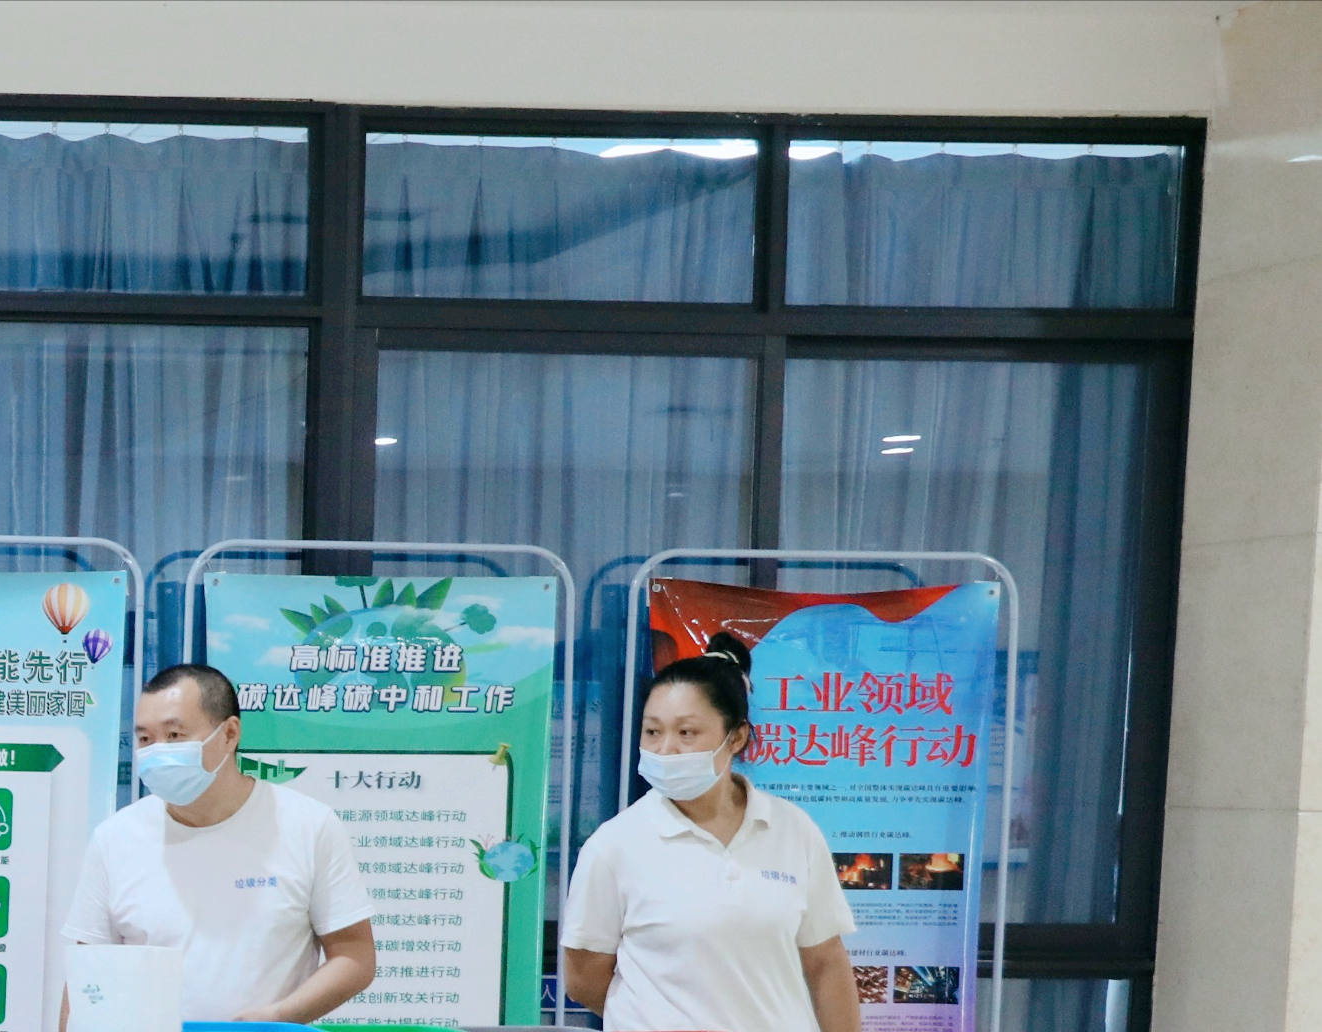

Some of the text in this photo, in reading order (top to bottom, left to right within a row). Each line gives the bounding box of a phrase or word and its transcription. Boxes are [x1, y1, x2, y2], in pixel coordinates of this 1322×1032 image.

[289, 644, 465, 673] 高标准推进
[238, 683, 515, 713] 碳达峰碳中和工作
[760, 672, 954, 716] 工业领域
[741, 722, 977, 768] 碳达峰行动
[326, 769, 423, 791] 十大行动
[234, 876, 278, 889] 垃圾分类
[760, 869, 798, 885] 垃圾分类
